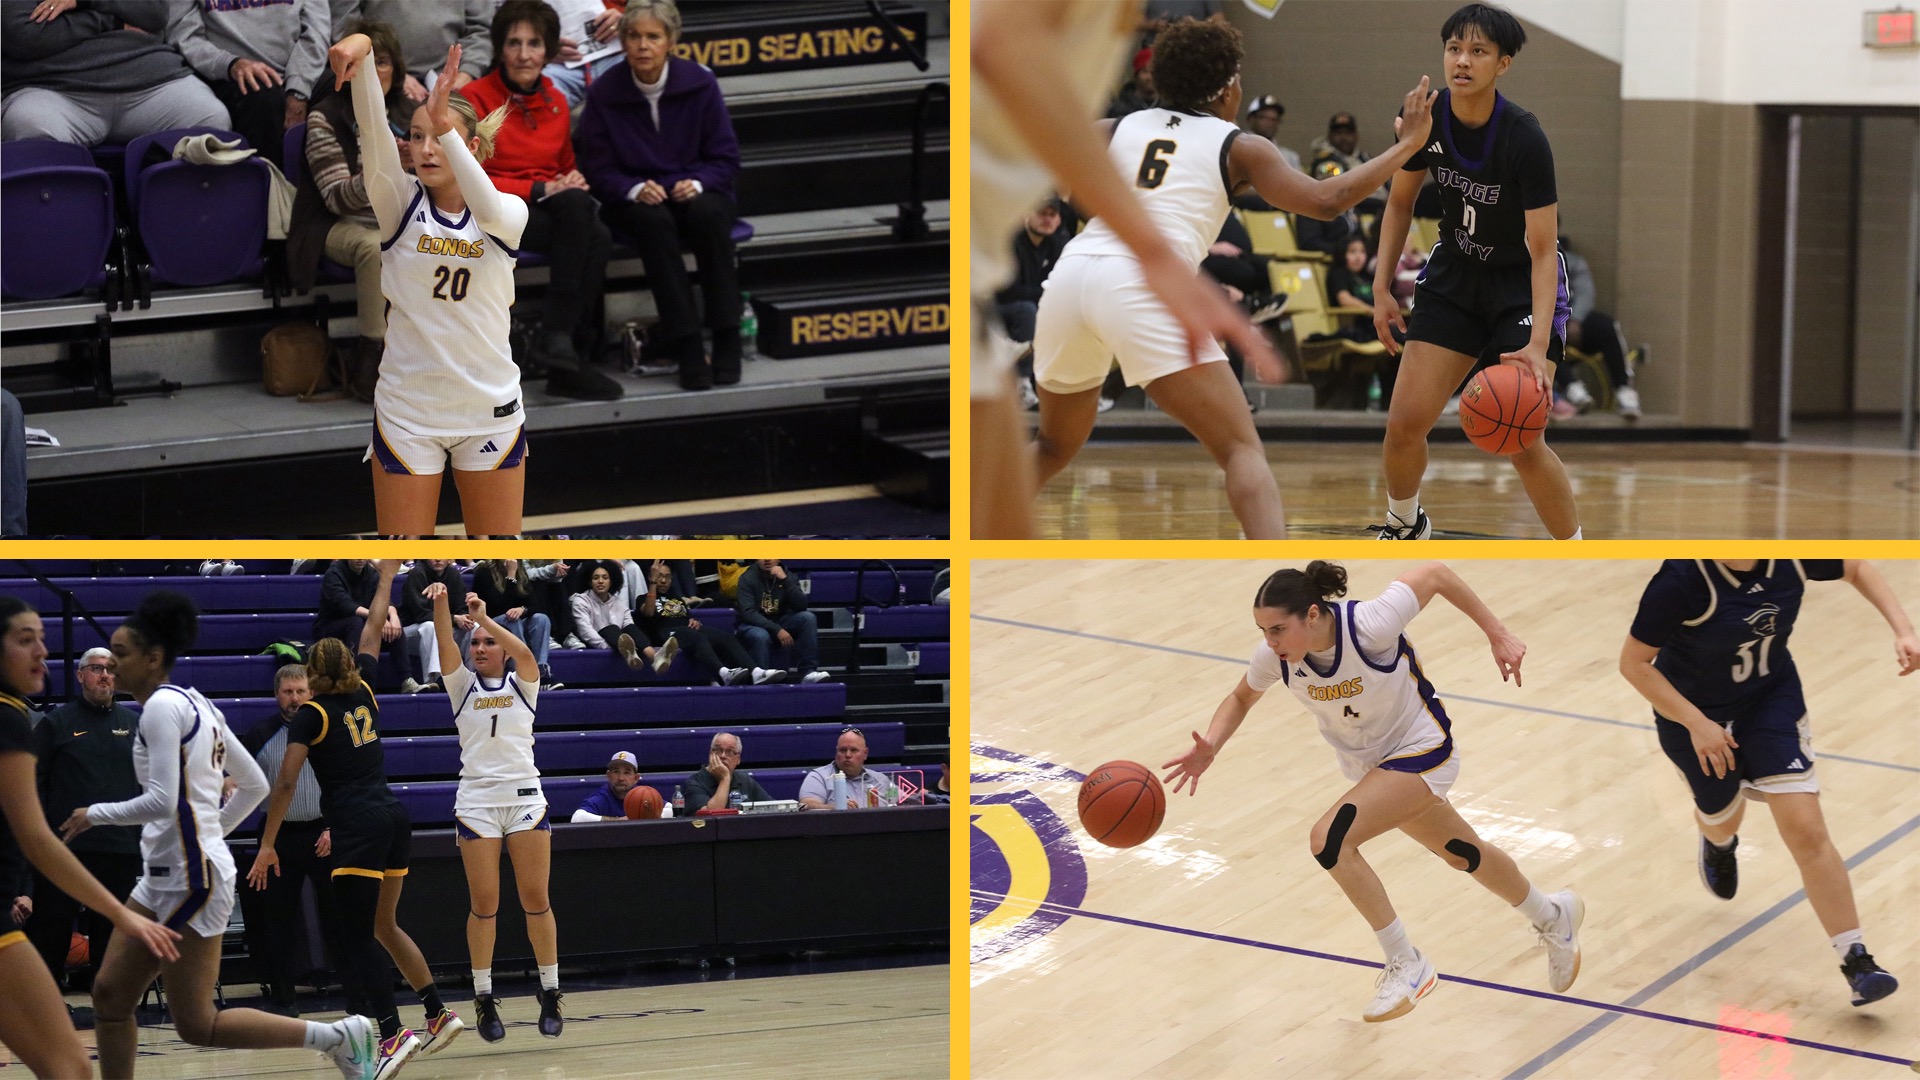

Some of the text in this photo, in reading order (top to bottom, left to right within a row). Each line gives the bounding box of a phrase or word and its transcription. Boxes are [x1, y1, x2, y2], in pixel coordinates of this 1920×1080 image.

[758, 26, 884, 62] SEATING
[1136, 138, 1178, 190] 6
[1438, 166, 1501, 205] DODGE
[416, 233, 484, 259] CONQS
[1454, 228, 1494, 261] CITY
[432, 265, 471, 302] 20
[791, 303, 949, 345] RESERVED
[1731, 634, 1777, 684] 31
[473, 695, 514, 711] CONQS
[1307, 676, 1364, 702] CONQS
[343, 705, 378, 748] 12
[490, 714, 499, 738] 1
[1343, 704, 1360, 718] 4
